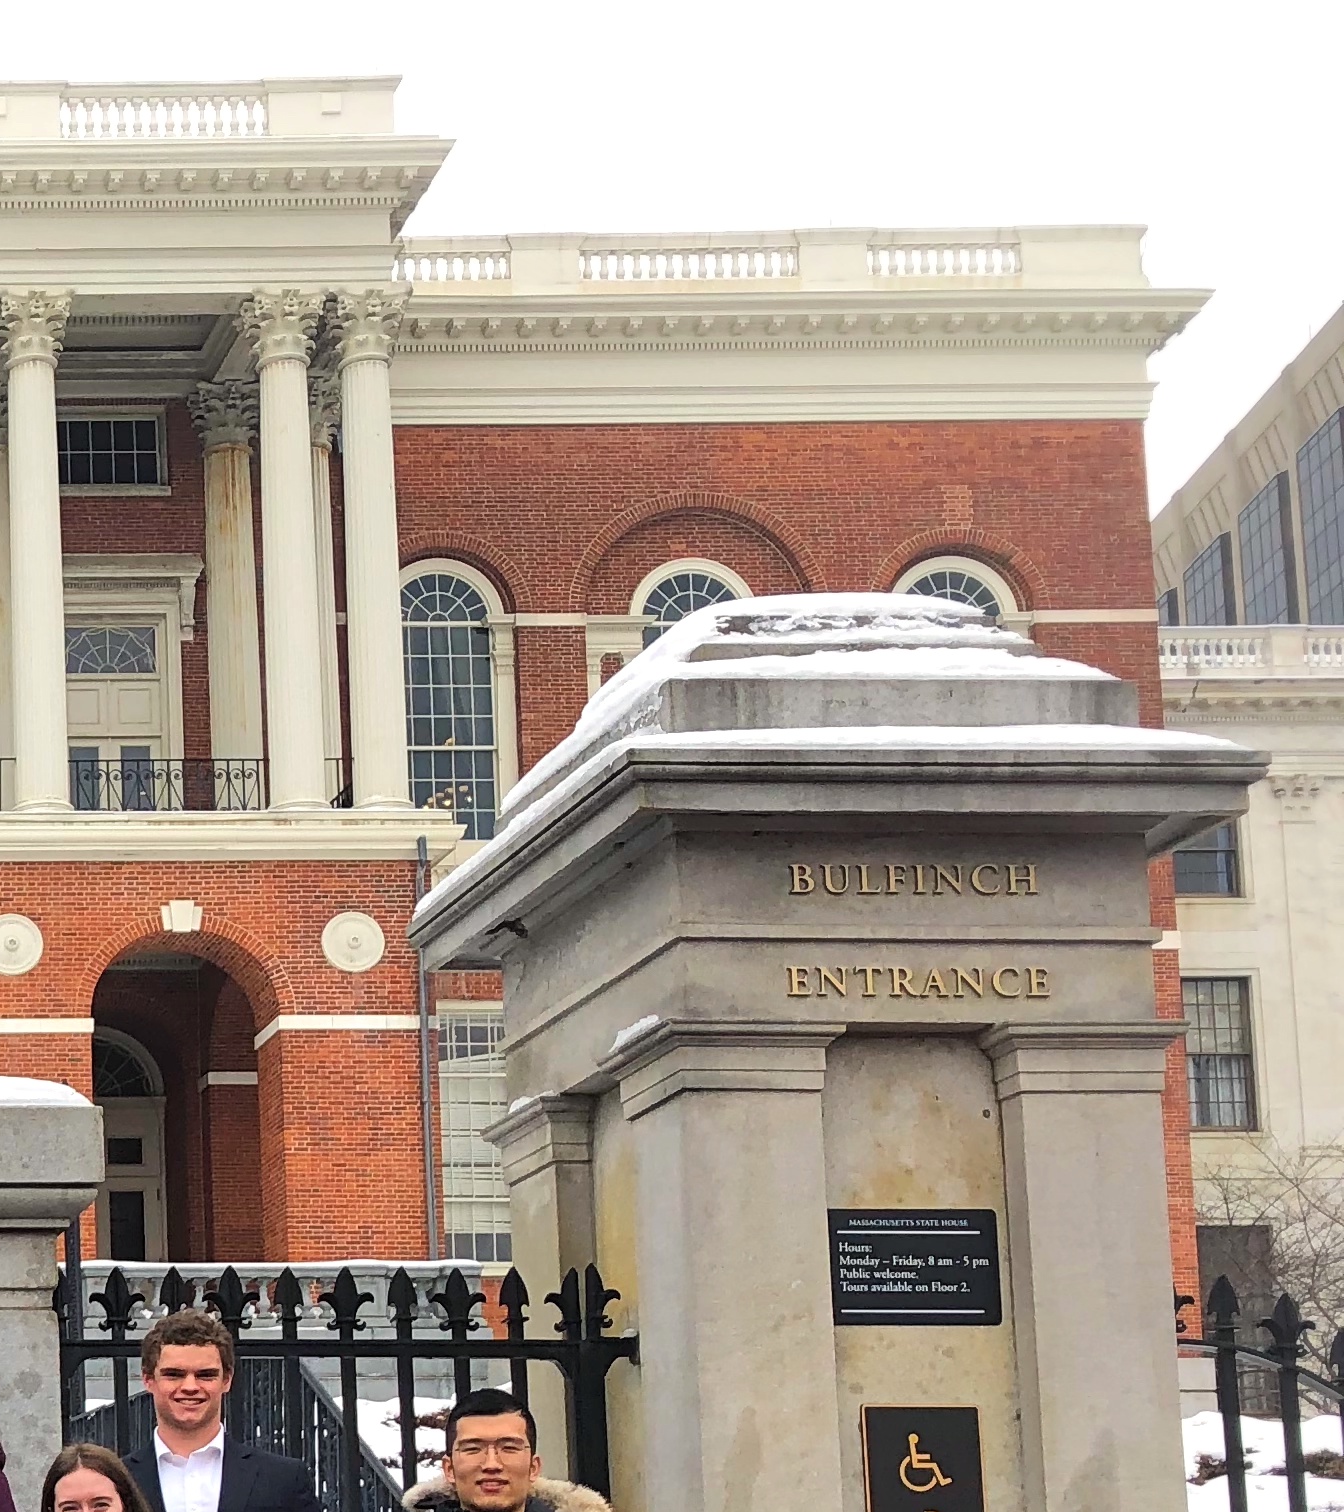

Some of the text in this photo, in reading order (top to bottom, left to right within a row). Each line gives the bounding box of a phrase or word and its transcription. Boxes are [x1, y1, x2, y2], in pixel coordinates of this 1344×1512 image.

[788, 863, 1040, 895] BULFINCH
[786, 965, 1052, 999] ENTRANCE
[848, 1219, 969, 1227] MASSACHUSETTS STATE HOUSE
[838, 1242, 872, 1252] Hours:
[839, 1256, 880, 1267] Monday
[892, 1255, 925, 1268] Friday,
[928, 1256, 934, 1266] 8
[937, 1258, 953, 1266] am
[963, 1256, 969, 1266] 5
[972, 1258, 989, 1268] pm
[839, 1269, 919, 1279] Public welcome.
[840, 1281, 970, 1292] Tours available on Floor 2.
